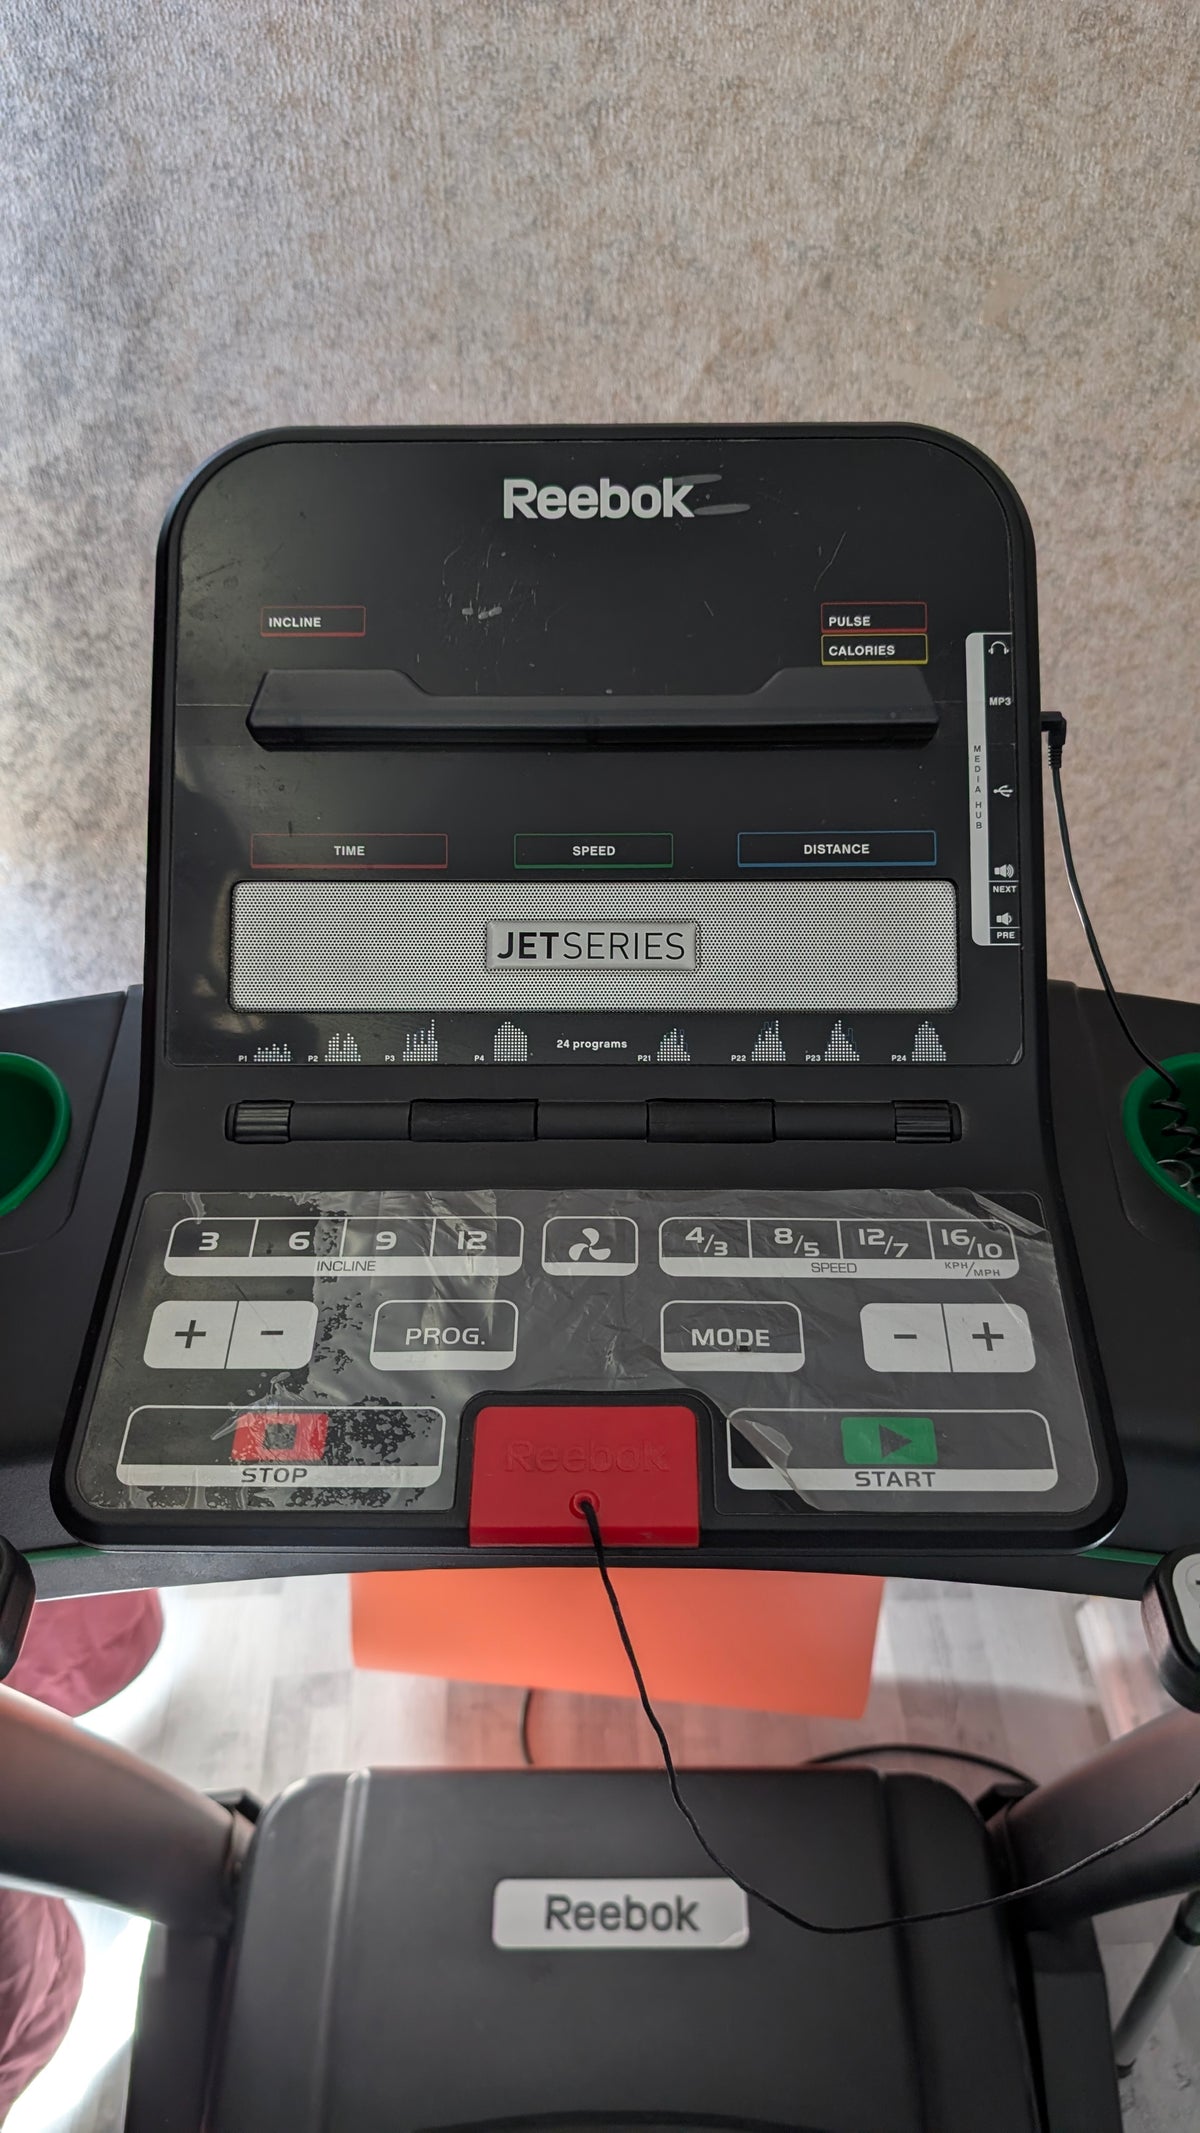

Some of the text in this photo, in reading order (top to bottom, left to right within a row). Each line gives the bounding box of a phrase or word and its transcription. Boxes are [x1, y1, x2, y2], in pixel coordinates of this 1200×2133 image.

[502, 477, 695, 521] Reebok
[268, 616, 322, 629] INCLINE
[828, 616, 871, 628] PULSE
[828, 644, 896, 657] CALORIES
[989, 696, 1012, 707] MP3
[973, 745, 983, 830] MEDIA HUB
[333, 845, 366, 857] TIME
[572, 845, 617, 857] SPEED
[803, 843, 871, 856] DISTANCE
[992, 884, 1017, 894] NEXT
[996, 930, 1016, 940] PRE
[556, 1038, 628, 1053] 24 programs
[238, 1054, 248, 1063] P1
[308, 1054, 319, 1063] P2
[384, 1054, 396, 1063] P3
[474, 1054, 485, 1063] P4
[637, 1054, 651, 1063] P21
[731, 1054, 747, 1063] P22
[805, 1054, 821, 1063] P23
[891, 1054, 907, 1063] P24
[198, 1232, 220, 1251] 3
[288, 1231, 311, 1251] 6
[375, 1231, 398, 1251] 9
[457, 1231, 488, 1251] 12
[316, 1260, 377, 1272] INCLINE
[810, 1262, 858, 1274] SPEED
[944, 1261, 1001, 1278] KPH/MPH
[405, 1328, 486, 1346] PROG.
[691, 1328, 770, 1348] MODE
[240, 1467, 308, 1484] STOP
[854, 1471, 937, 1488] START
[544, 1895, 701, 1931] Reebok
